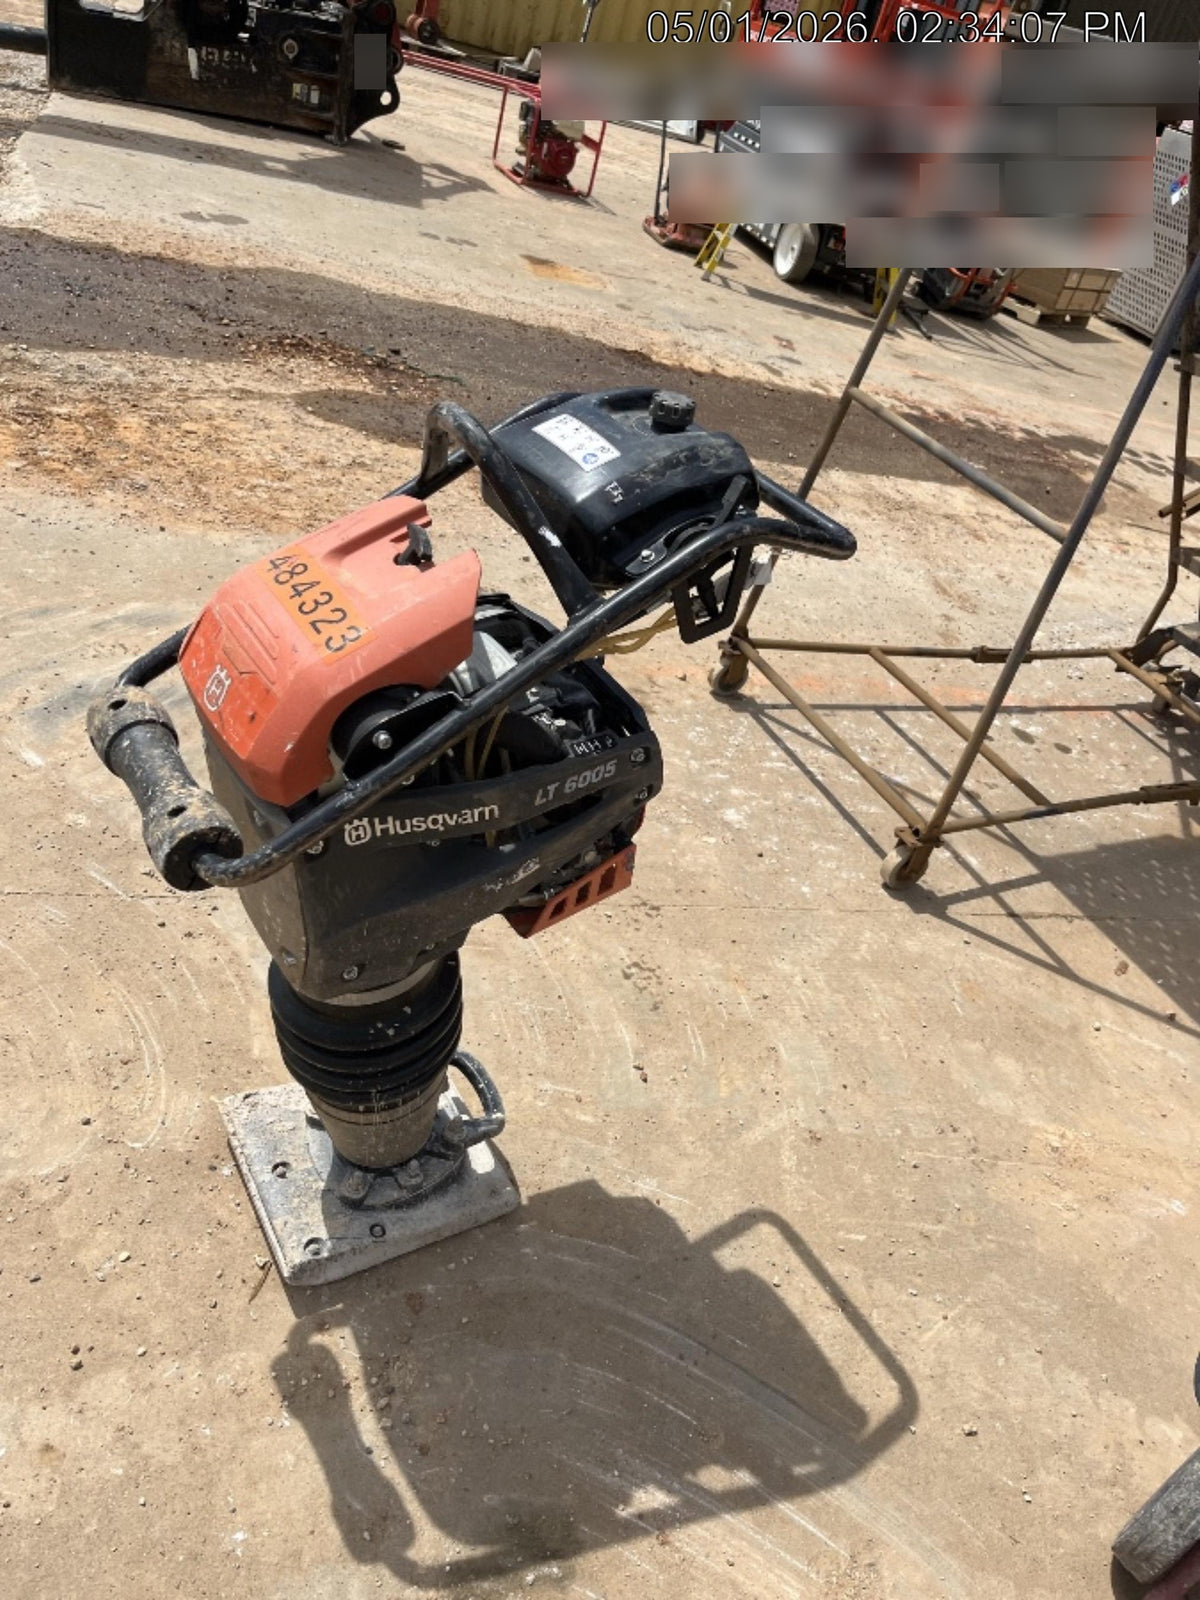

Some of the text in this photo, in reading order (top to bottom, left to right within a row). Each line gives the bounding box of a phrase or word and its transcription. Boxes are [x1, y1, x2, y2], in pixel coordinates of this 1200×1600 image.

[267, 554, 362, 652] 484323
[534, 759, 618, 806] LT 6005
